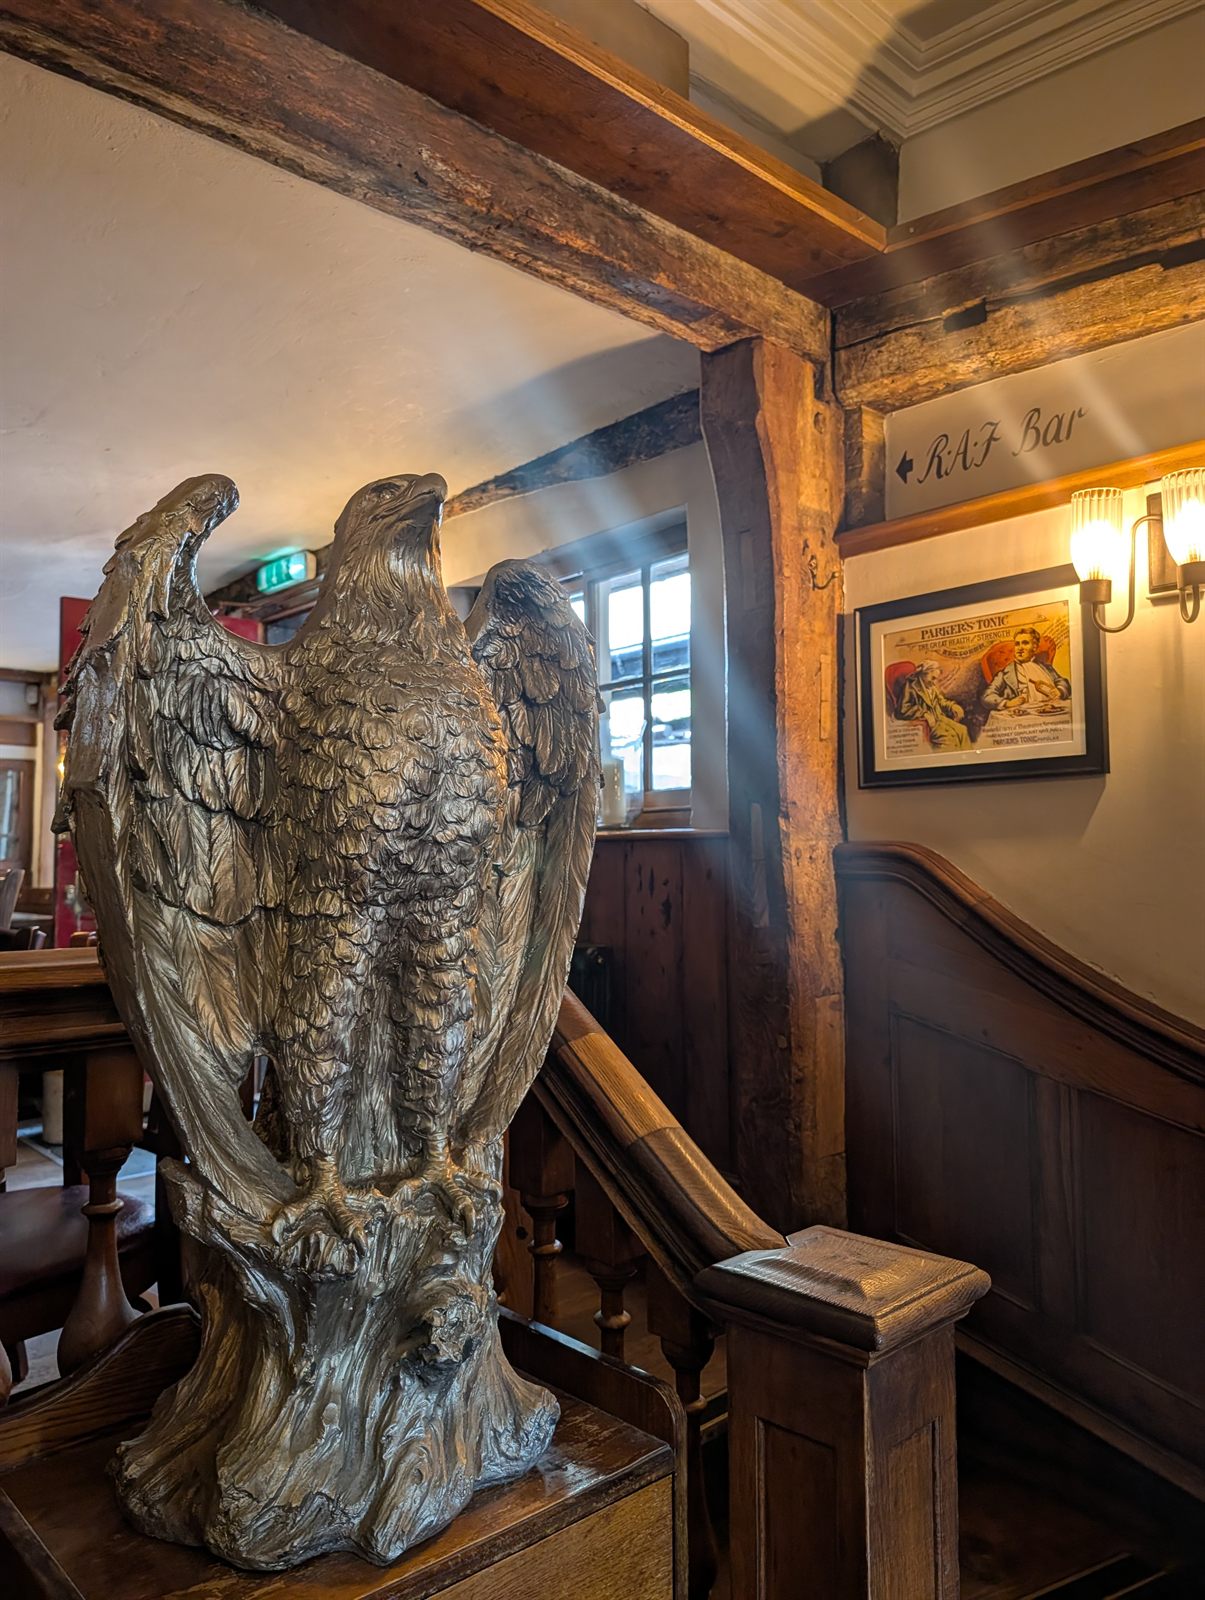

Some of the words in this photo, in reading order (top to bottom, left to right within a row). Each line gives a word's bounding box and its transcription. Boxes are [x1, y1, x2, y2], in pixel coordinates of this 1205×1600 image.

[1011, 407, 1088, 457] Bar
[976, 615, 1008, 630] TONIC
[930, 640, 947, 649] GREAT
[948, 636, 970, 647] HEALTH
[977, 629, 1011, 641] STRENGTH
